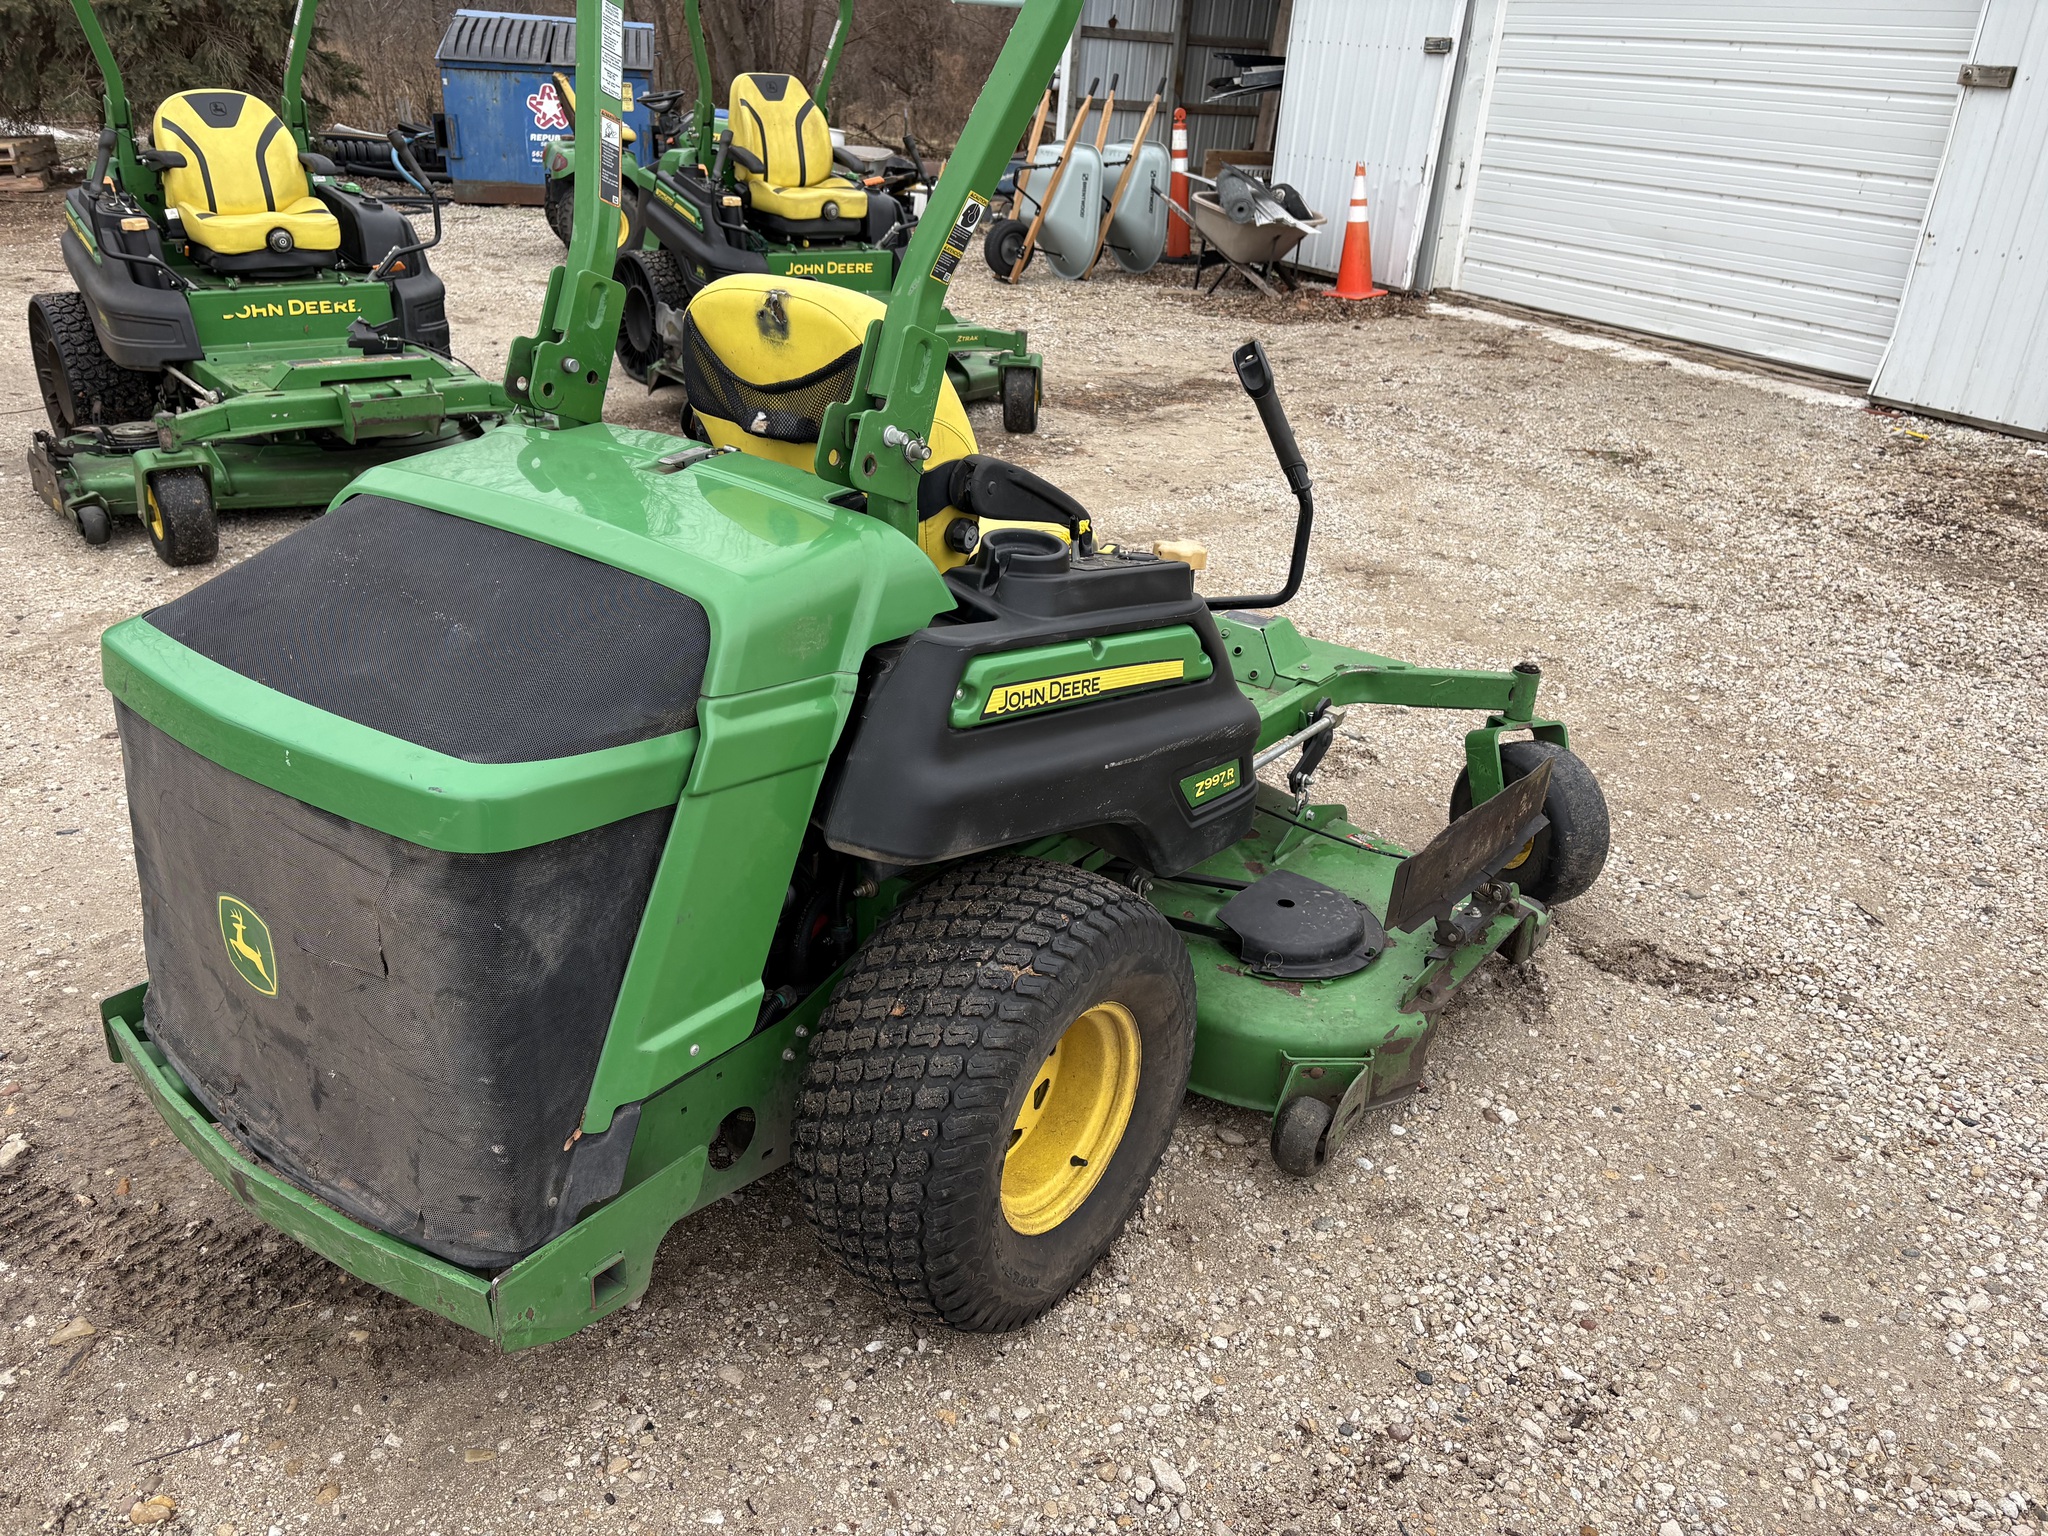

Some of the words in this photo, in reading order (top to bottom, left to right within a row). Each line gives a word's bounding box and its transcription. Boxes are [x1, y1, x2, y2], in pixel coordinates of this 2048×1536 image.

[785, 262, 824, 276] JOHN
[827, 261, 873, 274] DEERE
[222, 302, 284, 320] OHN
[998, 687, 1045, 711] JOHN
[1049, 677, 1101, 700] DEERE
[1195, 767, 1235, 798] Z997R
